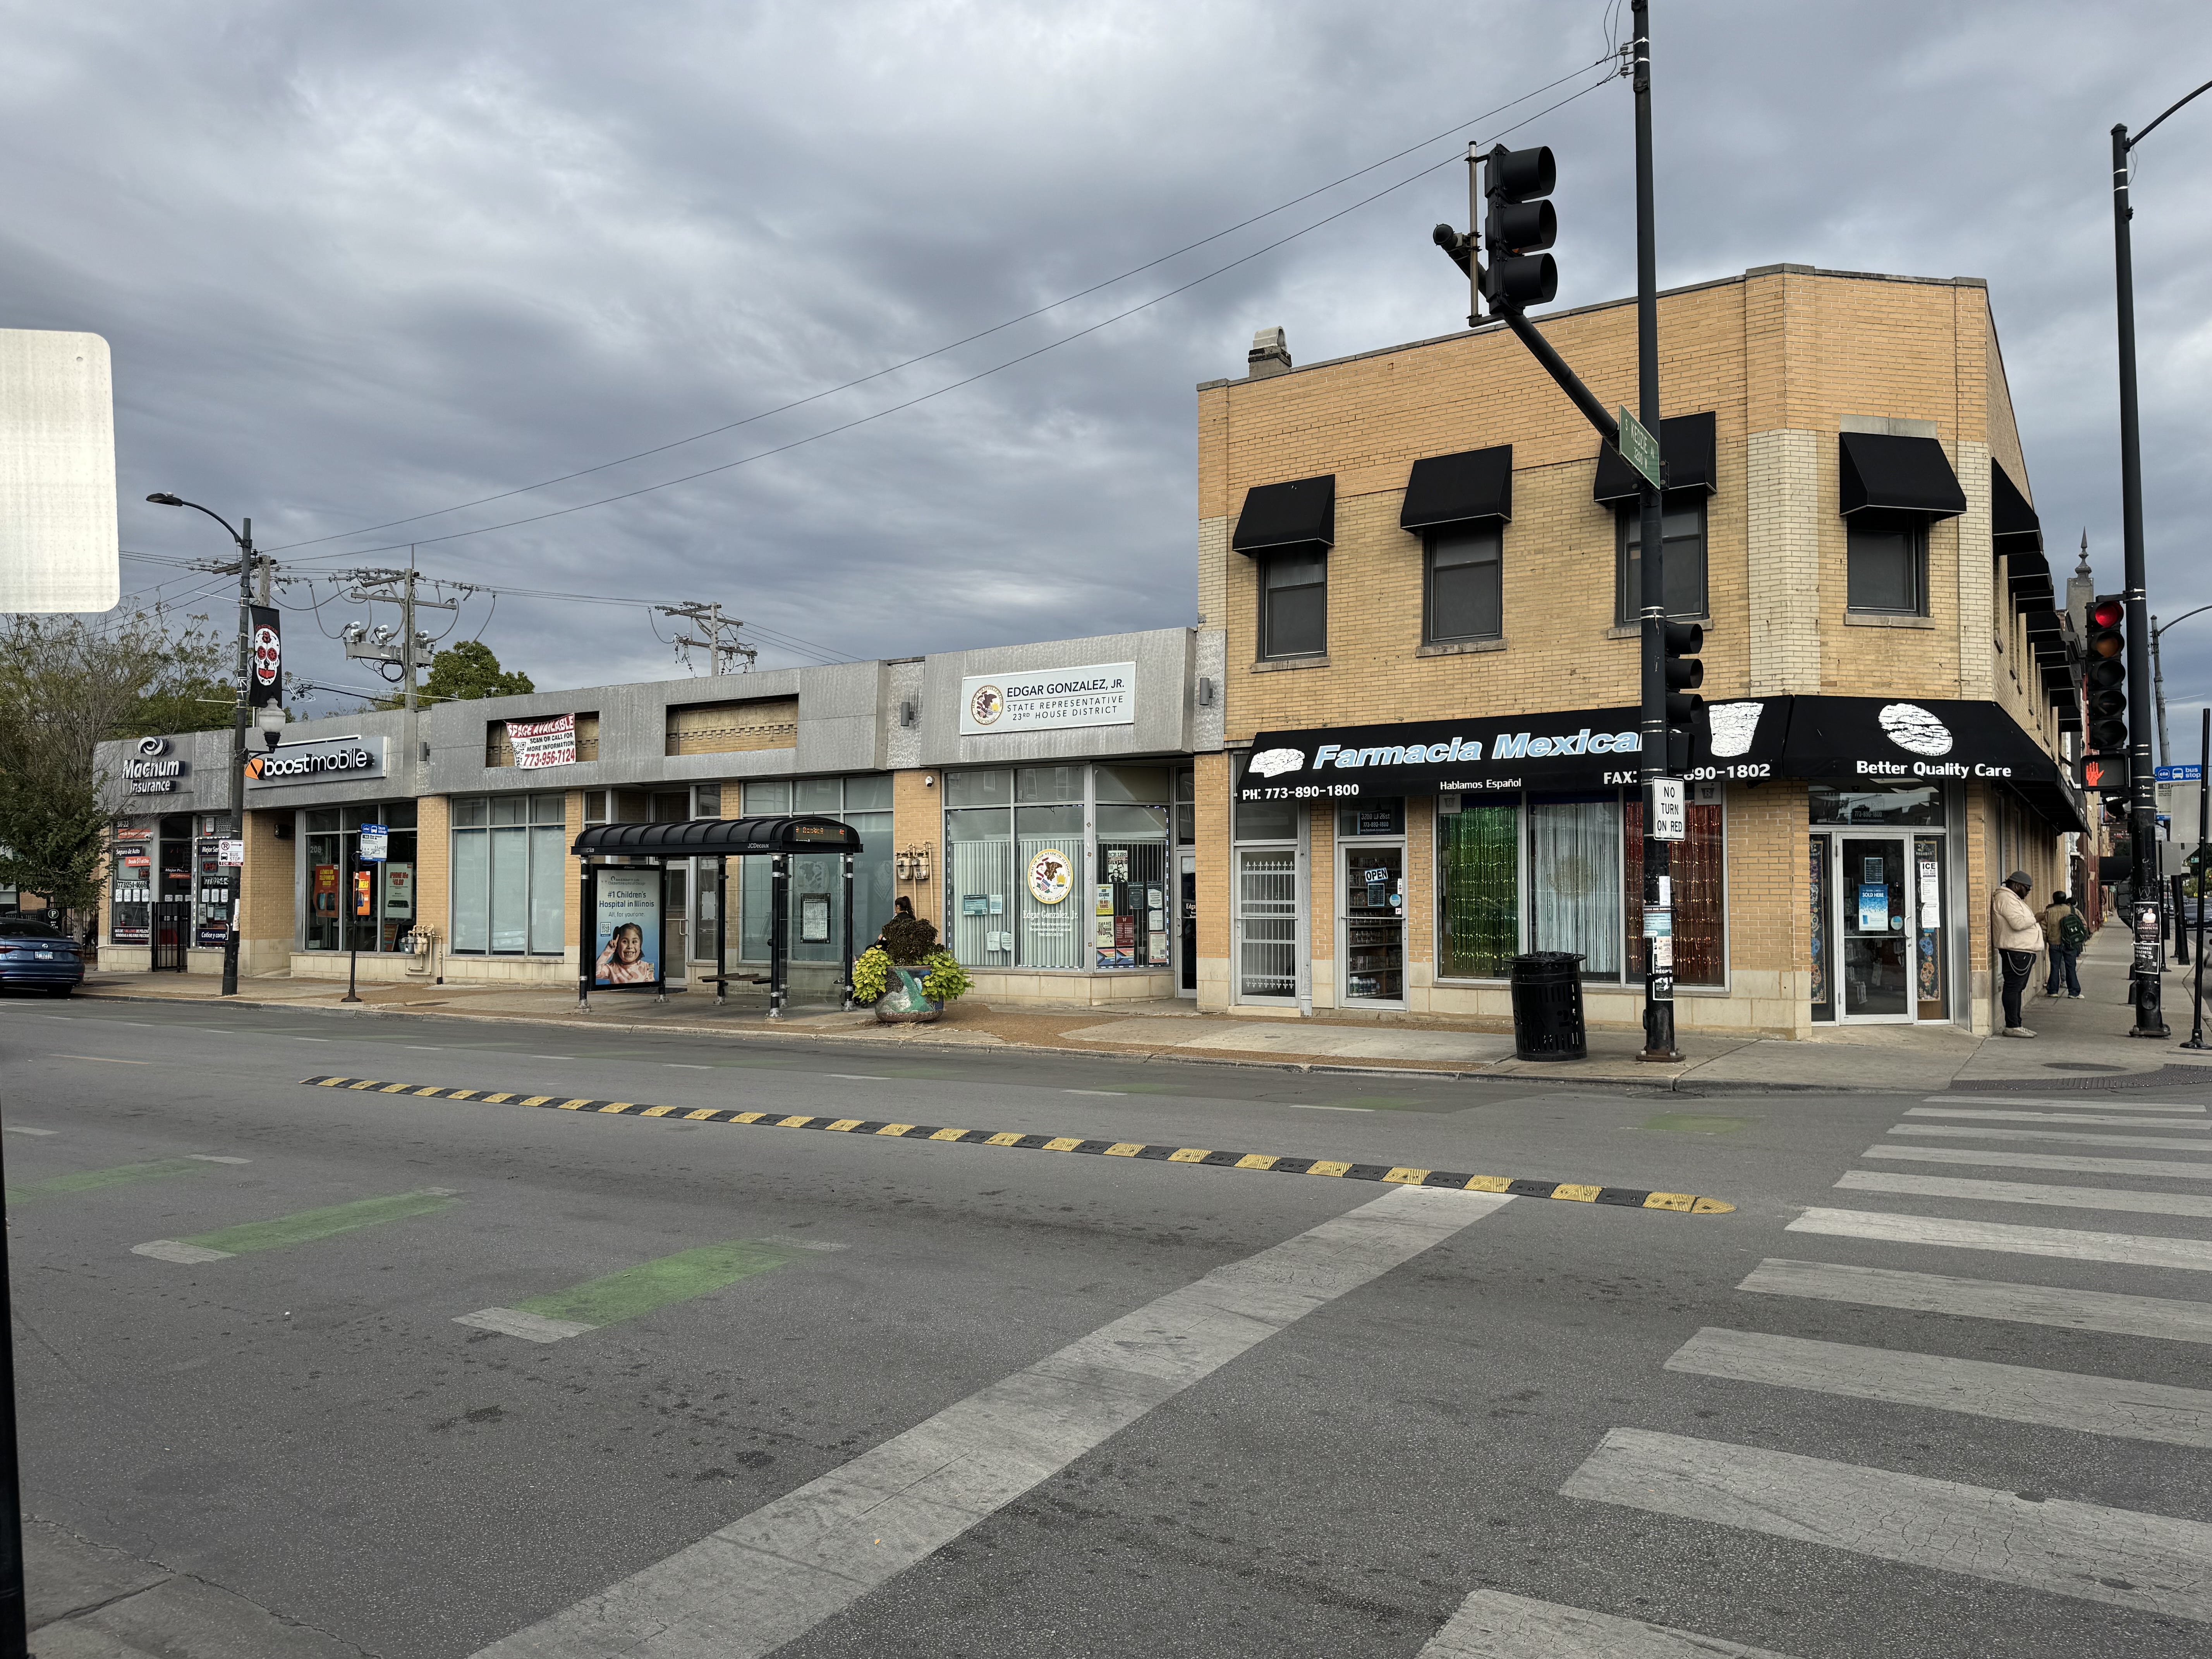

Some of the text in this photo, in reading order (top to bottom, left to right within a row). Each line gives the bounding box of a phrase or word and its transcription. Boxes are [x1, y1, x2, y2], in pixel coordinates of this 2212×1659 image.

[1631, 421, 1647, 454] KEDZIE
[1634, 447, 1643, 465] 3200
[1007, 679, 1124, 697] EDGAR GONZALEZ, JR.
[1007, 696, 1123, 712] STATE REPRESENTATIVE
[1035, 710, 1067, 719] HOUSE
[1072, 706, 1117, 716] DISTRICT
[508, 716, 574, 737] SPACE AVAILABLE
[1312, 728, 1642, 769] Farmacia Mexica
[524, 748, 575, 766] 773-956-7124
[122, 759, 179, 779] Magnum
[1856, 761, 2011, 779] Better Quality Care
[1440, 778, 1522, 790] Hablamos Español
[1604, 771, 1637, 784] FAX:
[130, 780, 170, 793] Insurance
[1242, 784, 1359, 800] PH: 773-890-1800
[1664, 787, 1675, 798] NO
[1661, 803, 1679, 815] TURN
[1657, 820, 1682, 832] ON RED
[1366, 869, 1387, 881] OPEN
[599, 900, 626, 909] Hospital
[1023, 910, 1040, 921] Edgar
[1041, 910, 1070, 920] Gonzalez,
